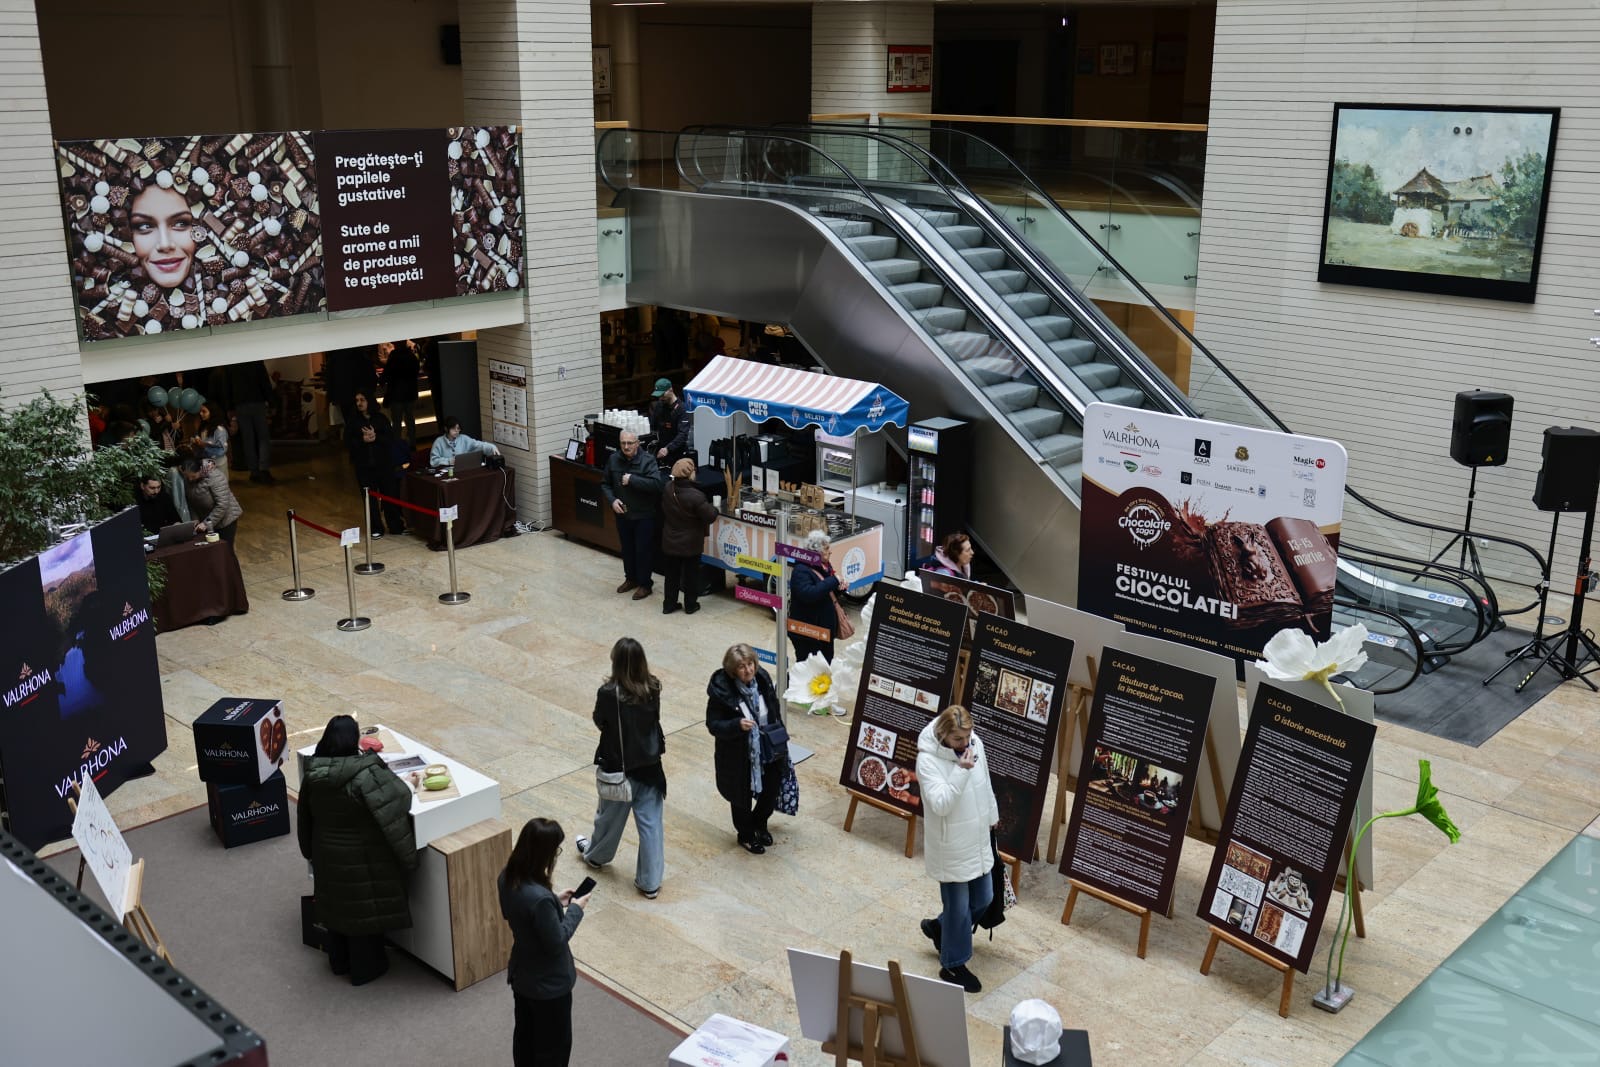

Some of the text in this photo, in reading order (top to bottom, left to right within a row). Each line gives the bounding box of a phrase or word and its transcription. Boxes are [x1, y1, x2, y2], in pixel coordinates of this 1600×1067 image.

[337, 171, 391, 189] papilele
[338, 186, 406, 207] gustative!
[340, 222, 390, 237] Sute de
[342, 235, 420, 254] arome a mii
[343, 252, 417, 271] de produse
[344, 275, 359, 288] te
[697, 397, 716, 405] GELATO
[748, 400, 768, 409] puro
[748, 408, 768, 417] vero
[804, 412, 825, 421] GELATO
[1102, 428, 1160, 449] VALRHONA
[1293, 455, 1315, 466] Magic
[1118, 516, 1172, 532] Chocolate
[1135, 528, 1155, 536] saga
[724, 543, 742, 553] puro
[1287, 537, 1314, 551] 13-15
[1293, 551, 1326, 567] martie
[1116, 563, 1191, 590] FESTIVALUL
[885, 593, 904, 603] CACAO
[1115, 575, 1238, 620] CIOCOLATEI
[890, 605, 941, 626] Boabele de cacao
[109, 608, 148, 641] VALRHONA
[920, 623, 929, 631] de
[929, 625, 951, 638] schimb
[986, 624, 1009, 636] CACAO
[1111, 660, 1136, 673] CACAO
[3, 668, 51, 708] VALRHONA
[1117, 683, 1125, 692] la
[1149, 683, 1159, 692] de
[1159, 688, 1184, 701] cacao,
[1267, 698, 1292, 713] CACAO
[1274, 714, 1347, 749] O istorie ancestrală
[204, 749, 250, 759] VALRHONA
[55, 737, 128, 798] VALRHONA
[231, 803, 280, 821] VALRHONA
